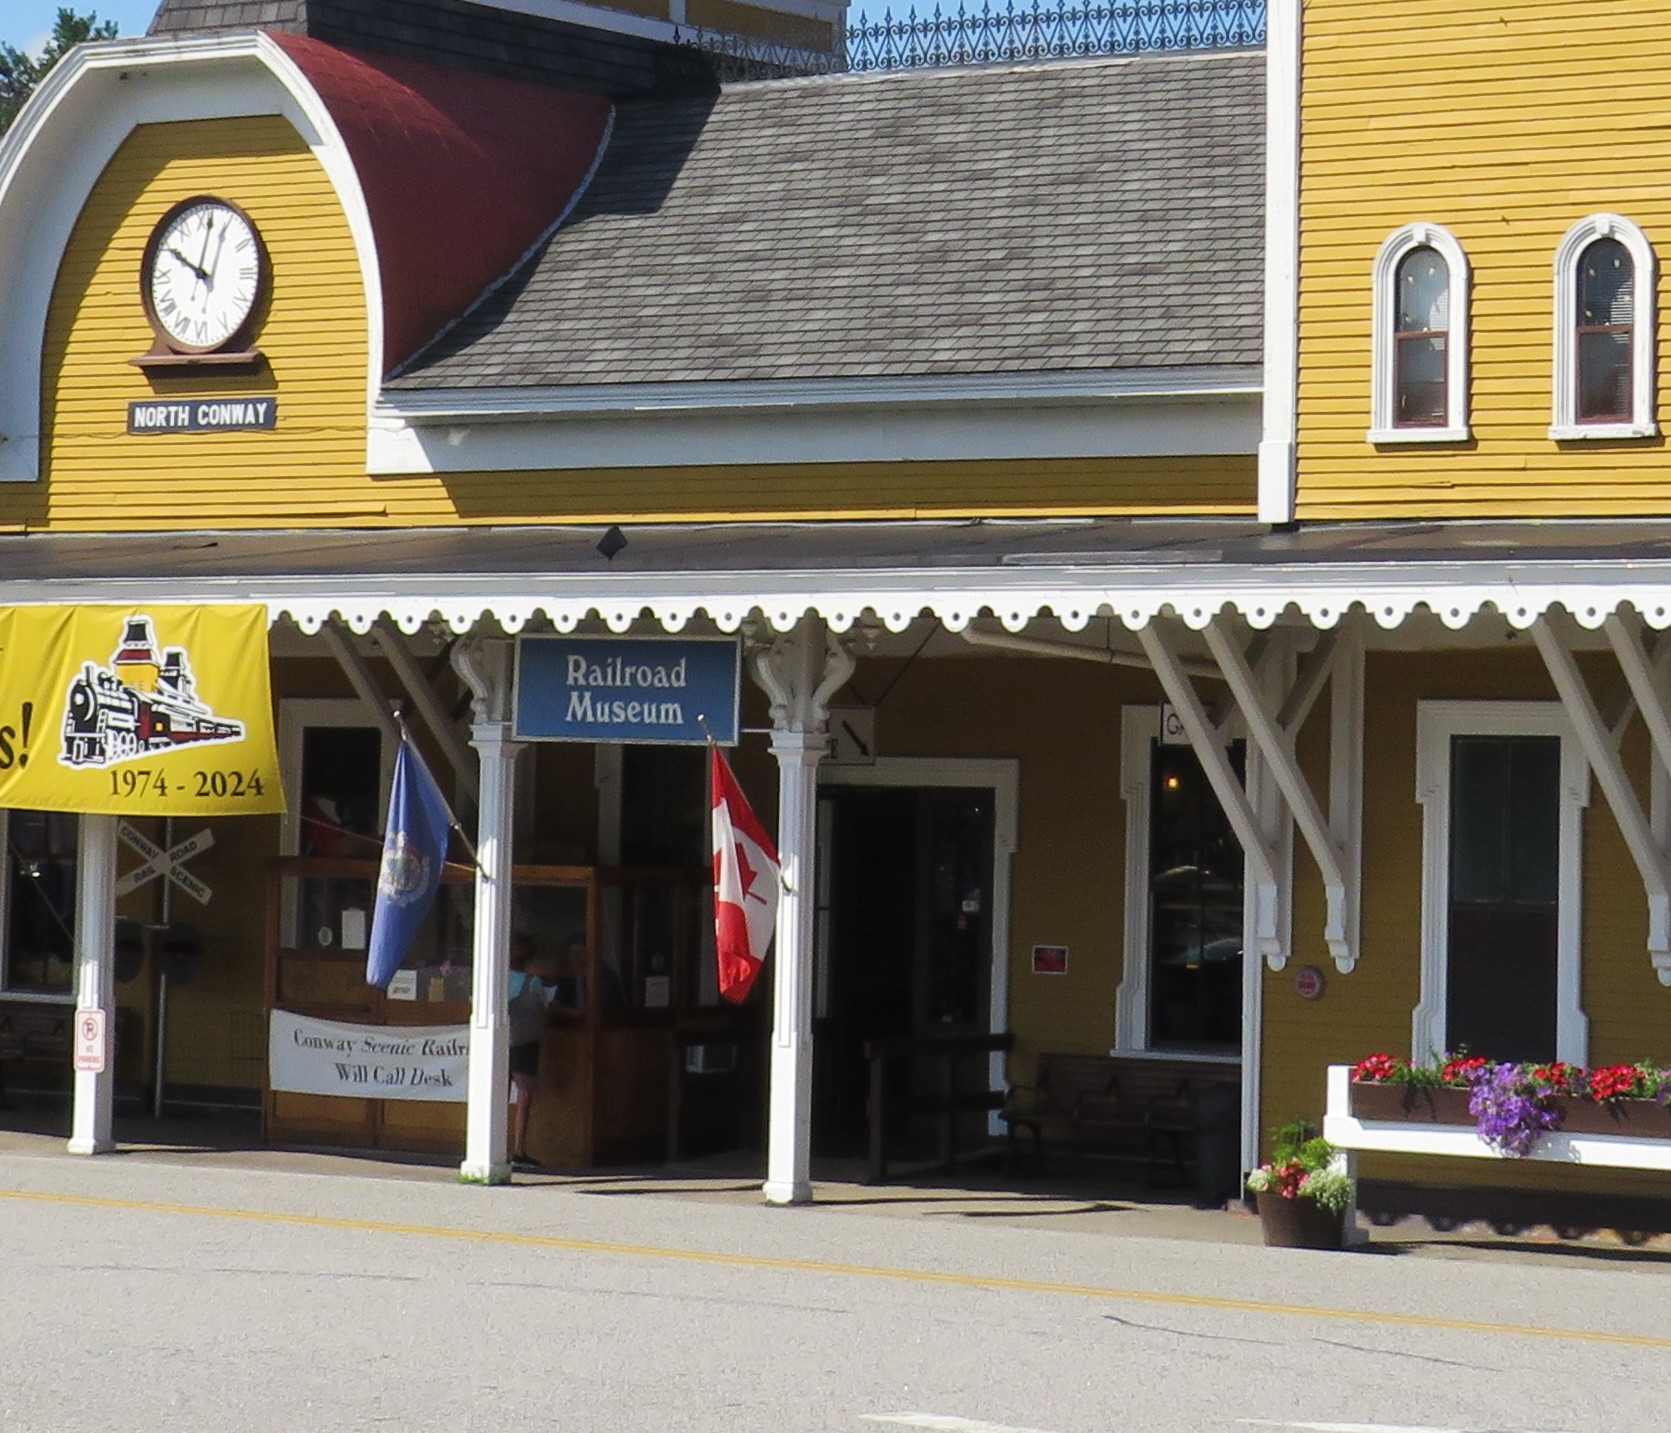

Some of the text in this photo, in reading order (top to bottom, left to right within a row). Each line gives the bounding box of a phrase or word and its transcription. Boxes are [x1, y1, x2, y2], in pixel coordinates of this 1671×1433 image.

[134, 402, 267, 428] NORTH CONWAY
[566, 654, 687, 688] Railroad
[565, 691, 685, 724] Museum
[110, 768, 168, 797] 1974
[193, 769, 265, 797] 2024
[121, 826, 205, 899] CONWAY SCENIC
[169, 840, 197, 862] ROAD
[293, 1029, 470, 1057] Conway Scenic Railr
[335, 1062, 453, 1087] Will Call Desk
